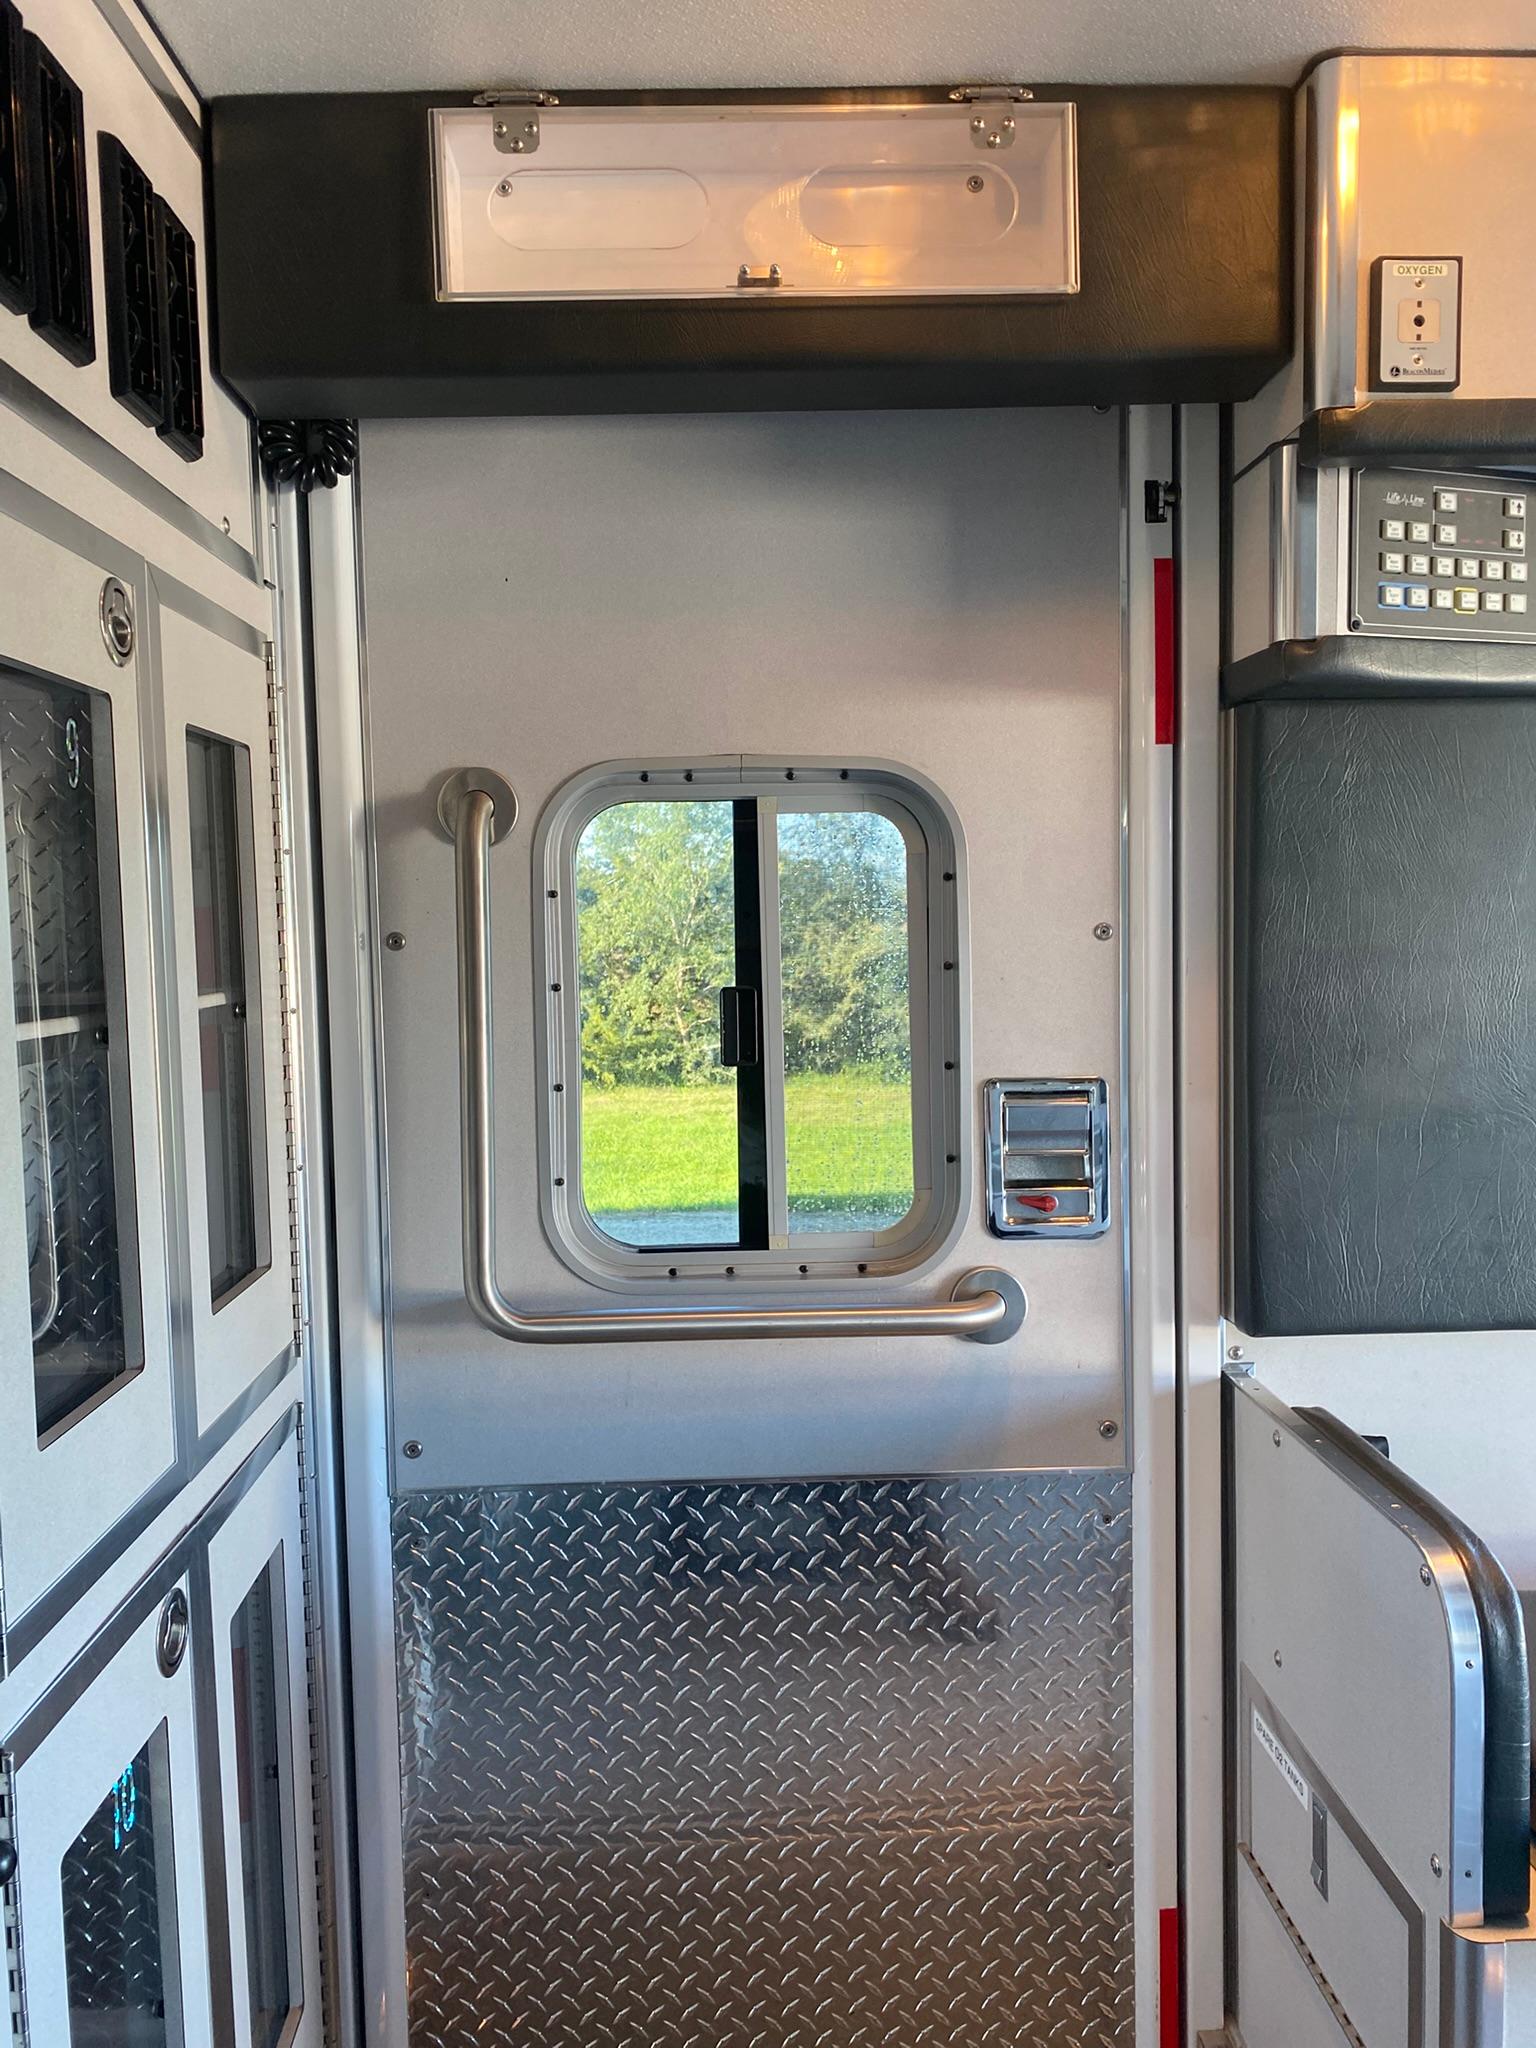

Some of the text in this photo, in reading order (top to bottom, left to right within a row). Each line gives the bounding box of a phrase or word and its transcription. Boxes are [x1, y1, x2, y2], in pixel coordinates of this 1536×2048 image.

[1397, 265, 1443, 275] OXYGEN
[66, 718, 79, 789] 9
[1255, 1717, 1304, 1797] SPARE O2 TANKS
